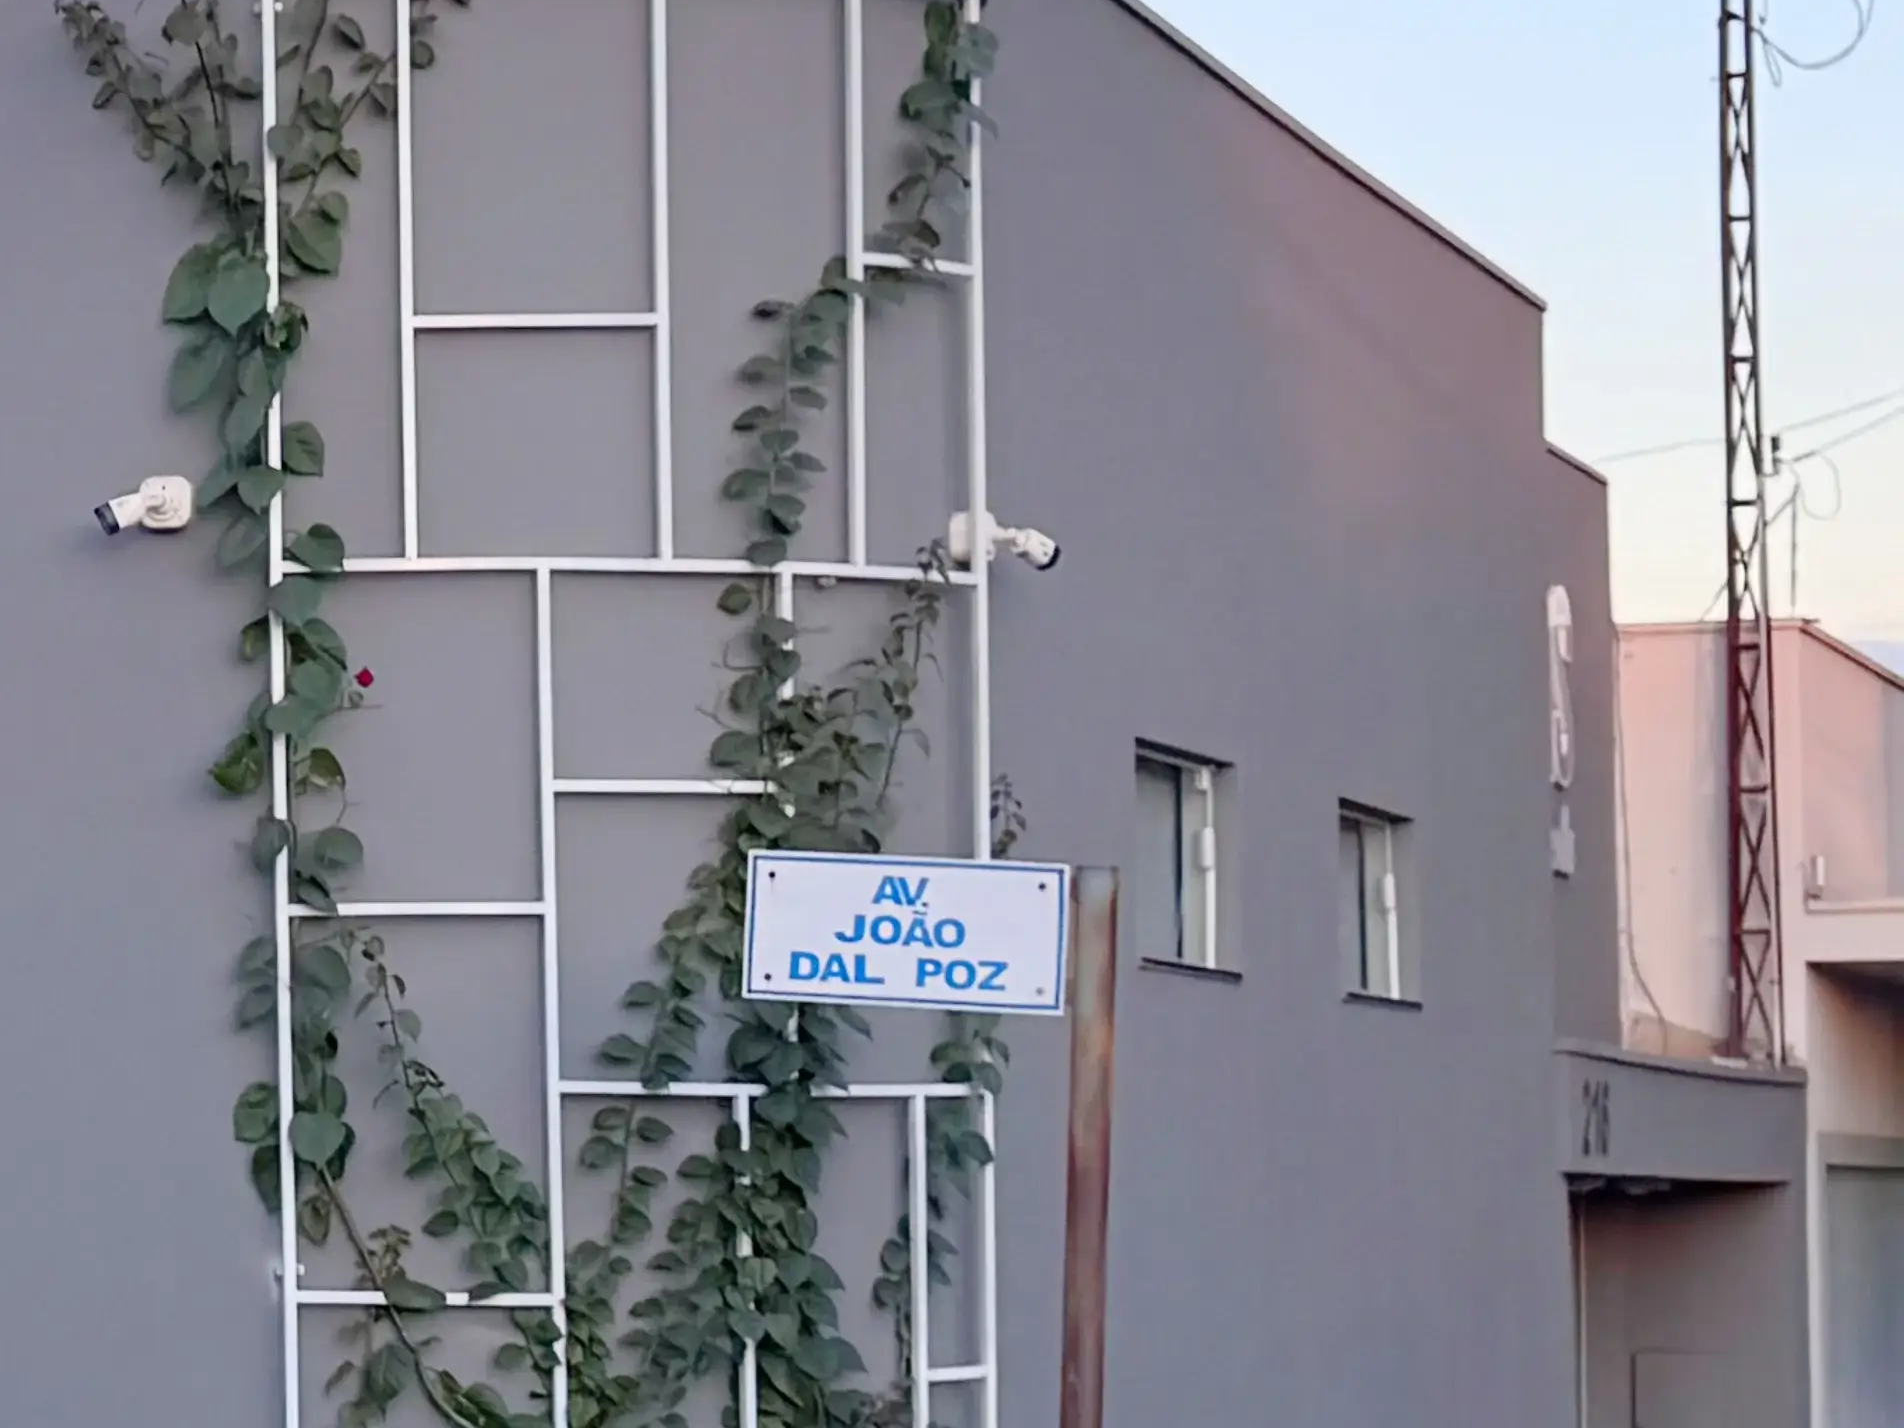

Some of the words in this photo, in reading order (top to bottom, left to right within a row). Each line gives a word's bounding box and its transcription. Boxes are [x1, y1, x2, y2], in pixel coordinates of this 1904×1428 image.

[872, 875, 930, 907] AV.
[834, 910, 966, 949] JOÃO
[788, 951, 885, 986] DAL
[915, 957, 1009, 992] POZ
